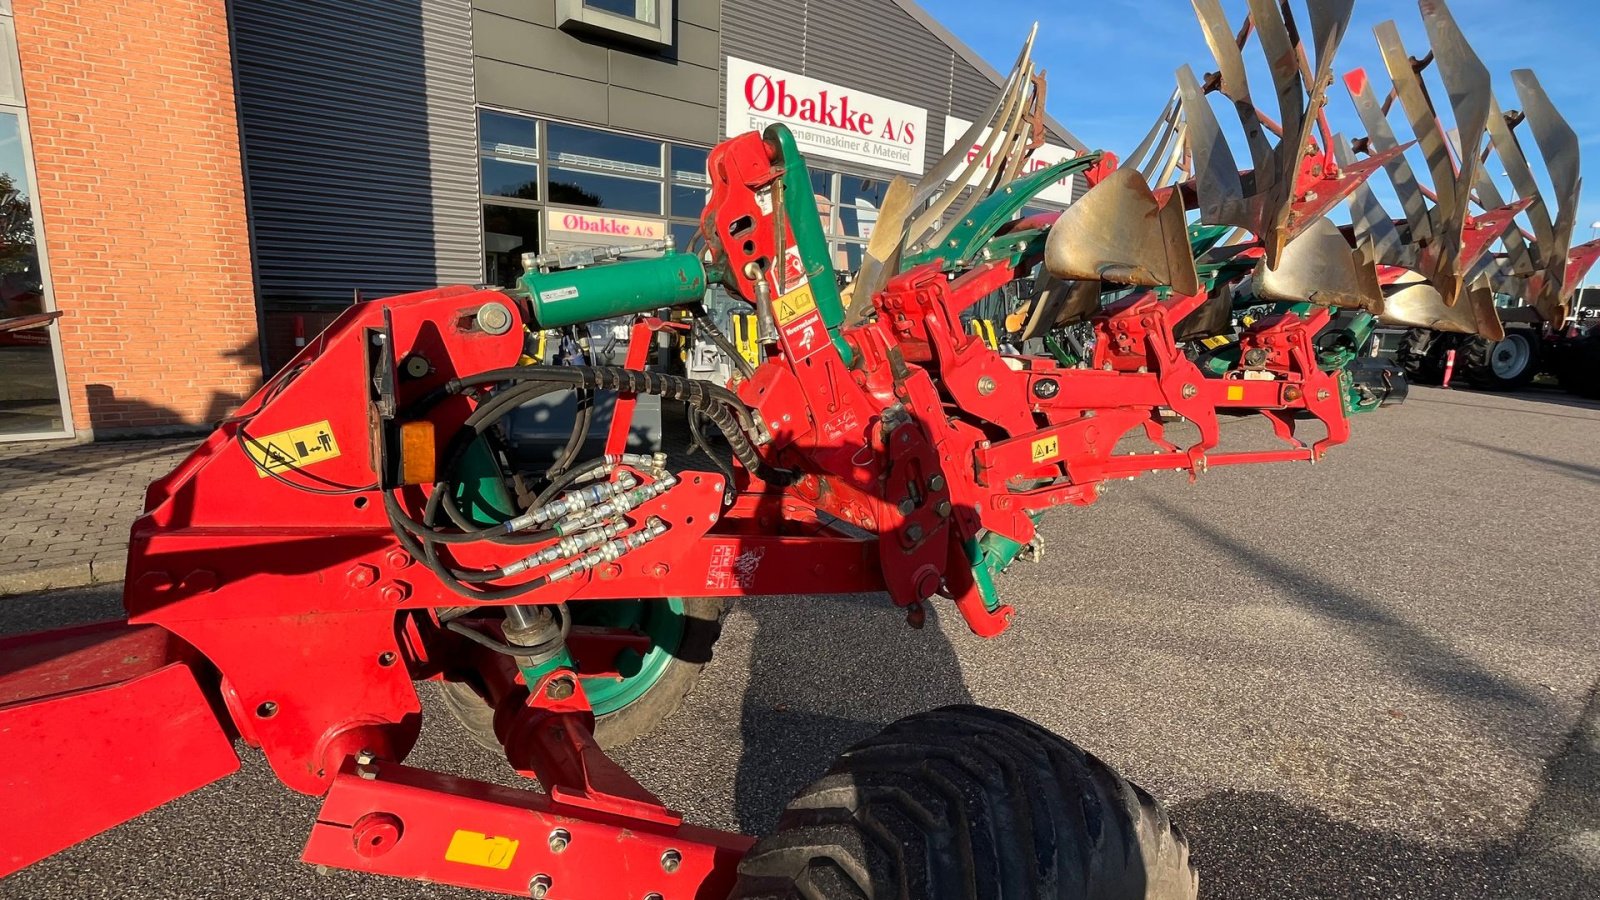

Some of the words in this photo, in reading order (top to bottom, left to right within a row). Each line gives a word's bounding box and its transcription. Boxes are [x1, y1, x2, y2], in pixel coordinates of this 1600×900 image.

[744, 73, 873, 135] Øbakke
[880, 117, 915, 145] A/S
[863, 141, 871, 153] &
[873, 143, 910, 162] Materiel
[563, 214, 630, 235] Øbakke
[633, 226, 654, 237] A/S
